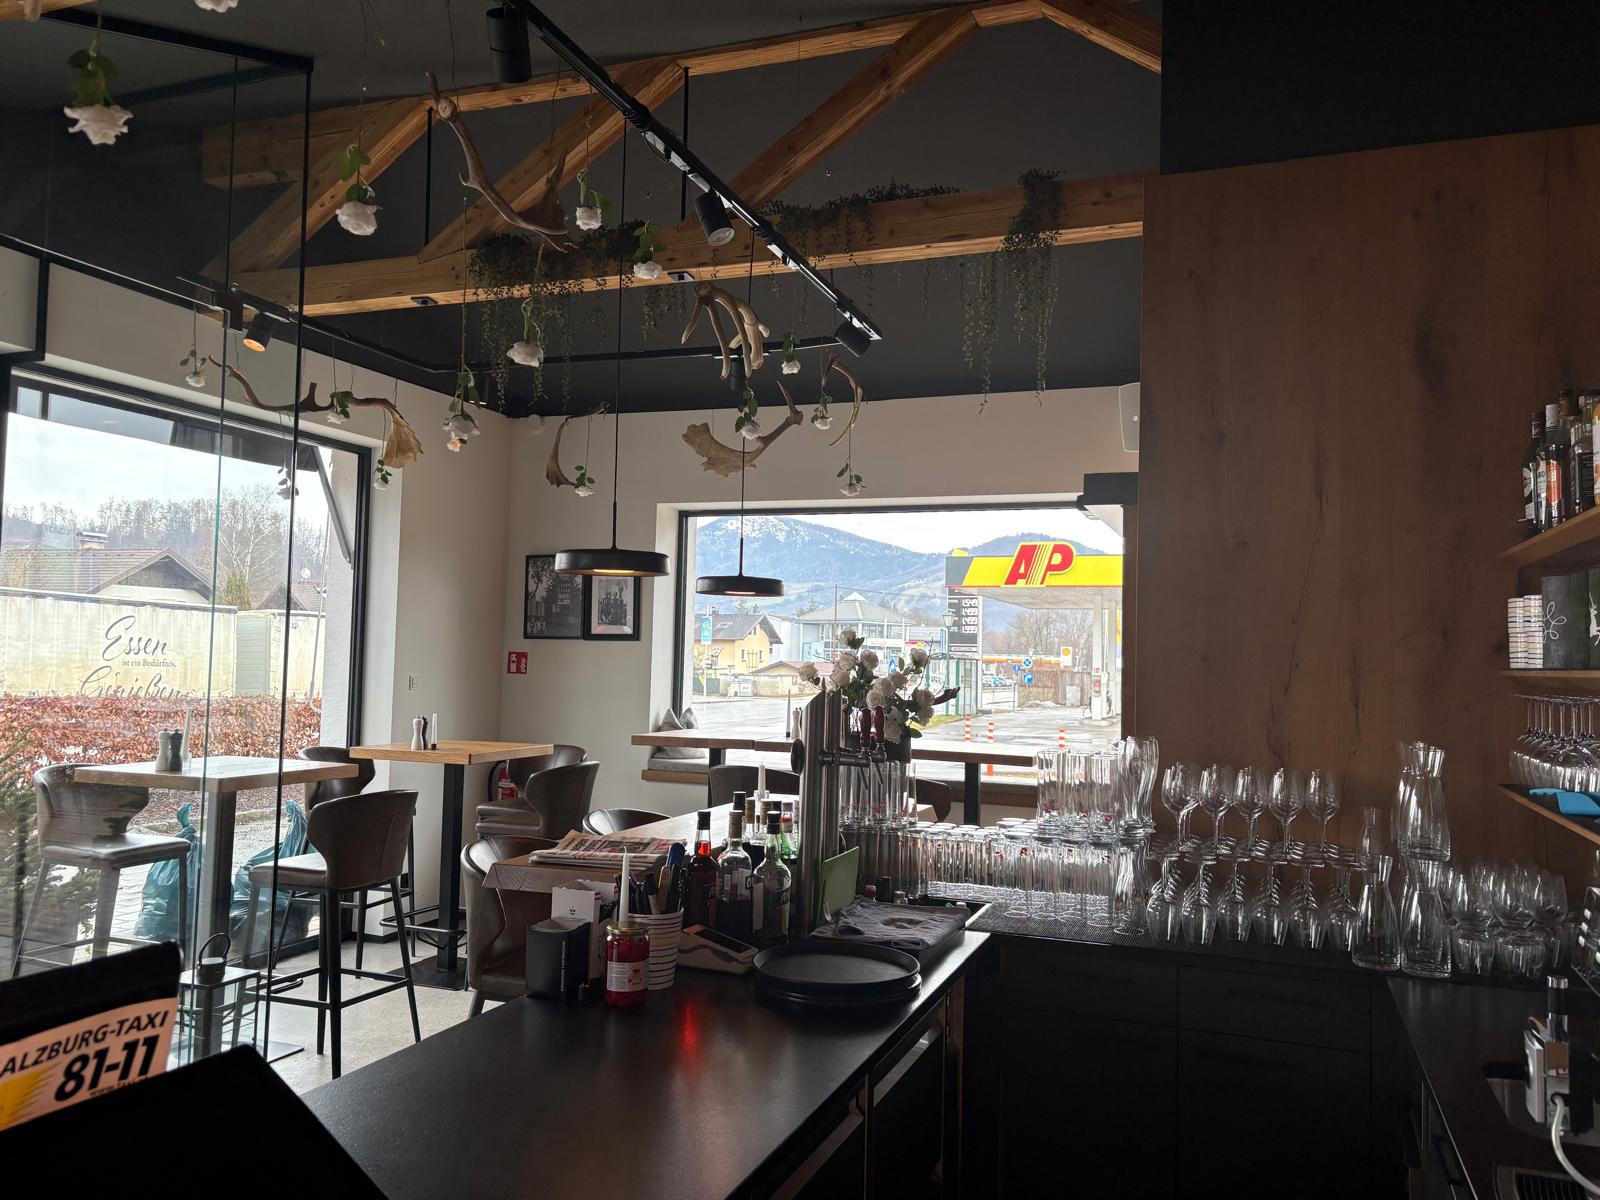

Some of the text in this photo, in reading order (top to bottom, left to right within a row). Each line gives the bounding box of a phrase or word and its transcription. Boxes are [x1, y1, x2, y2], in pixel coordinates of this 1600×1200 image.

[1004, 543, 1074, 586] AP
[102, 615, 168, 662] Essen
[122, 658, 130, 667] ist
[131, 658, 141, 667] ein
[0, 1010, 169, 1077] ALZBURG-TAXI
[54, 1034, 161, 1102] 81-11
